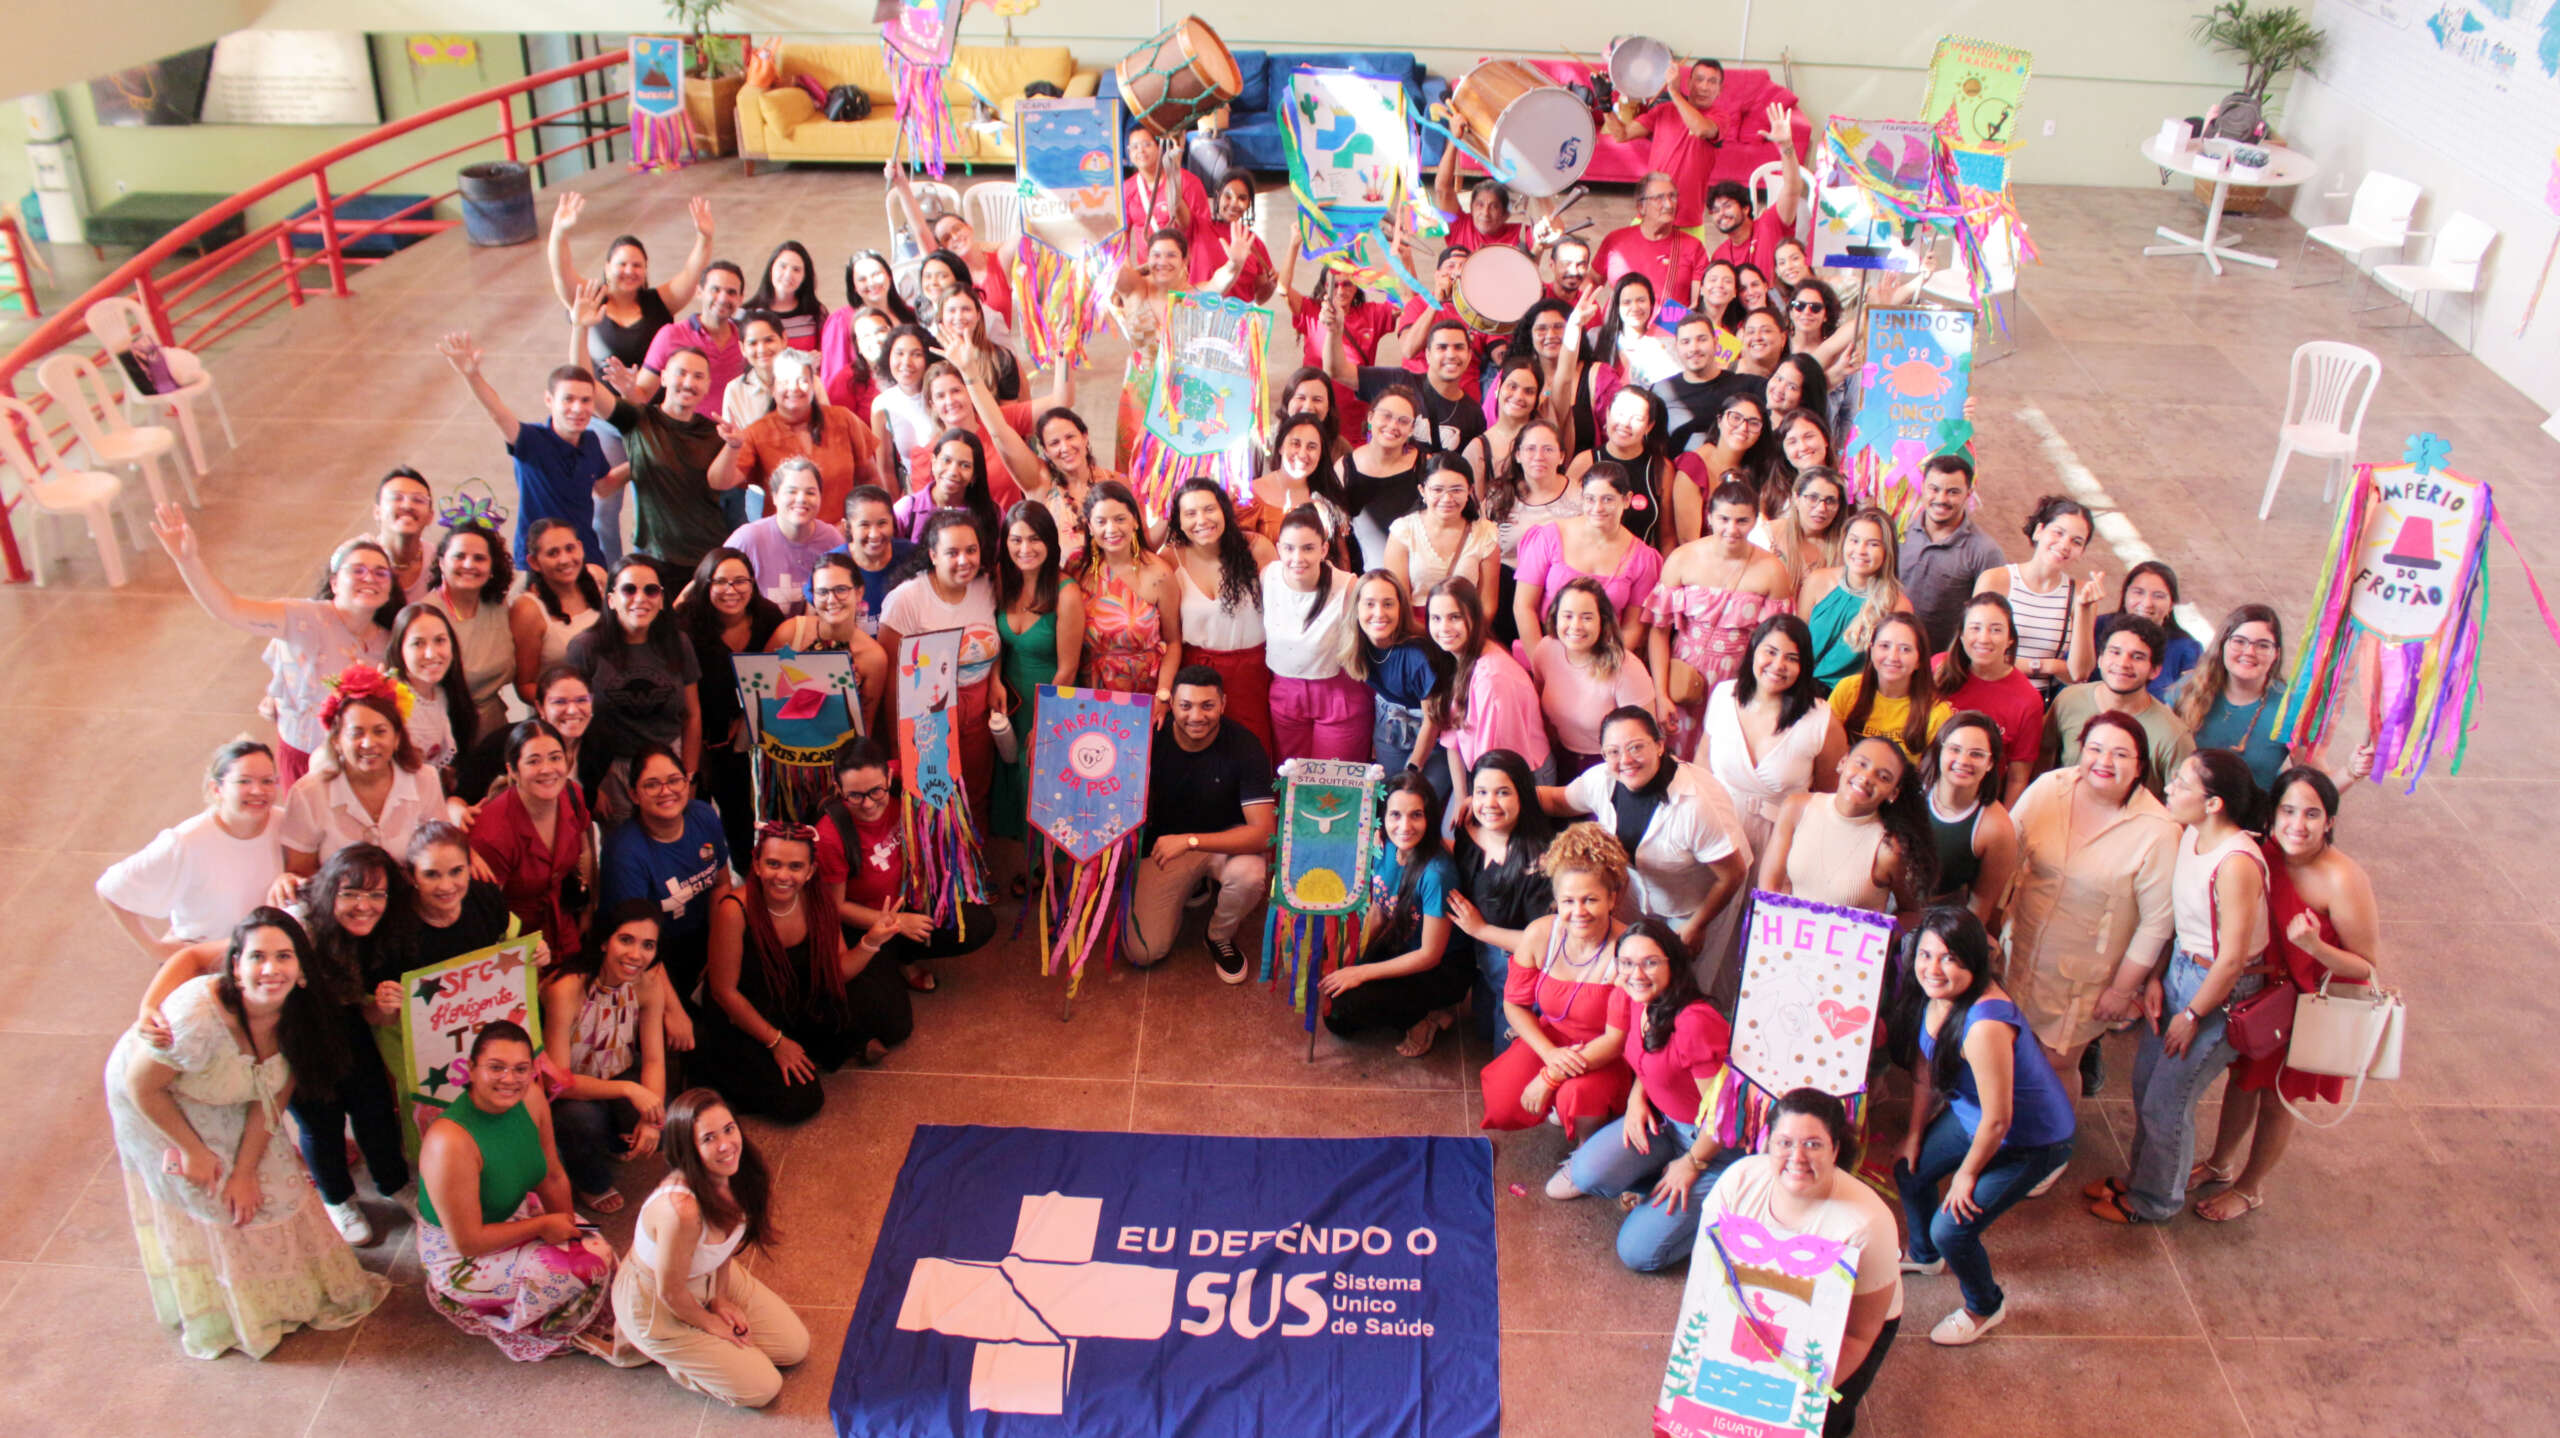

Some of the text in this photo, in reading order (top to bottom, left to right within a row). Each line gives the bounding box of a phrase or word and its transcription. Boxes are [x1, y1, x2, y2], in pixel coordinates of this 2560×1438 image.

[1875, 313, 1966, 334] UNIDOS
[1875, 331, 1906, 351] DA
[1889, 403, 1945, 423] ONCO
[2396, 568, 2418, 581] DO
[2353, 567, 2443, 607] FROTÃO
[1052, 709, 1132, 741] PARAÍSO
[1058, 767, 1122, 799] DA PED
[1296, 775, 1316, 784] STA
[1763, 914, 1883, 965] HGCC
[439, 960, 494, 998] SFC
[1116, 1226, 1177, 1253] EU
[1406, 1227, 1437, 1255] O
[1332, 1271, 1422, 1292] Sistema
[1180, 1268, 1329, 1340] SUS
[1332, 1294, 1397, 1313] Unico
[1330, 1317, 1435, 1337] de Saúde
[1712, 1415, 1764, 1438] IGUATU
